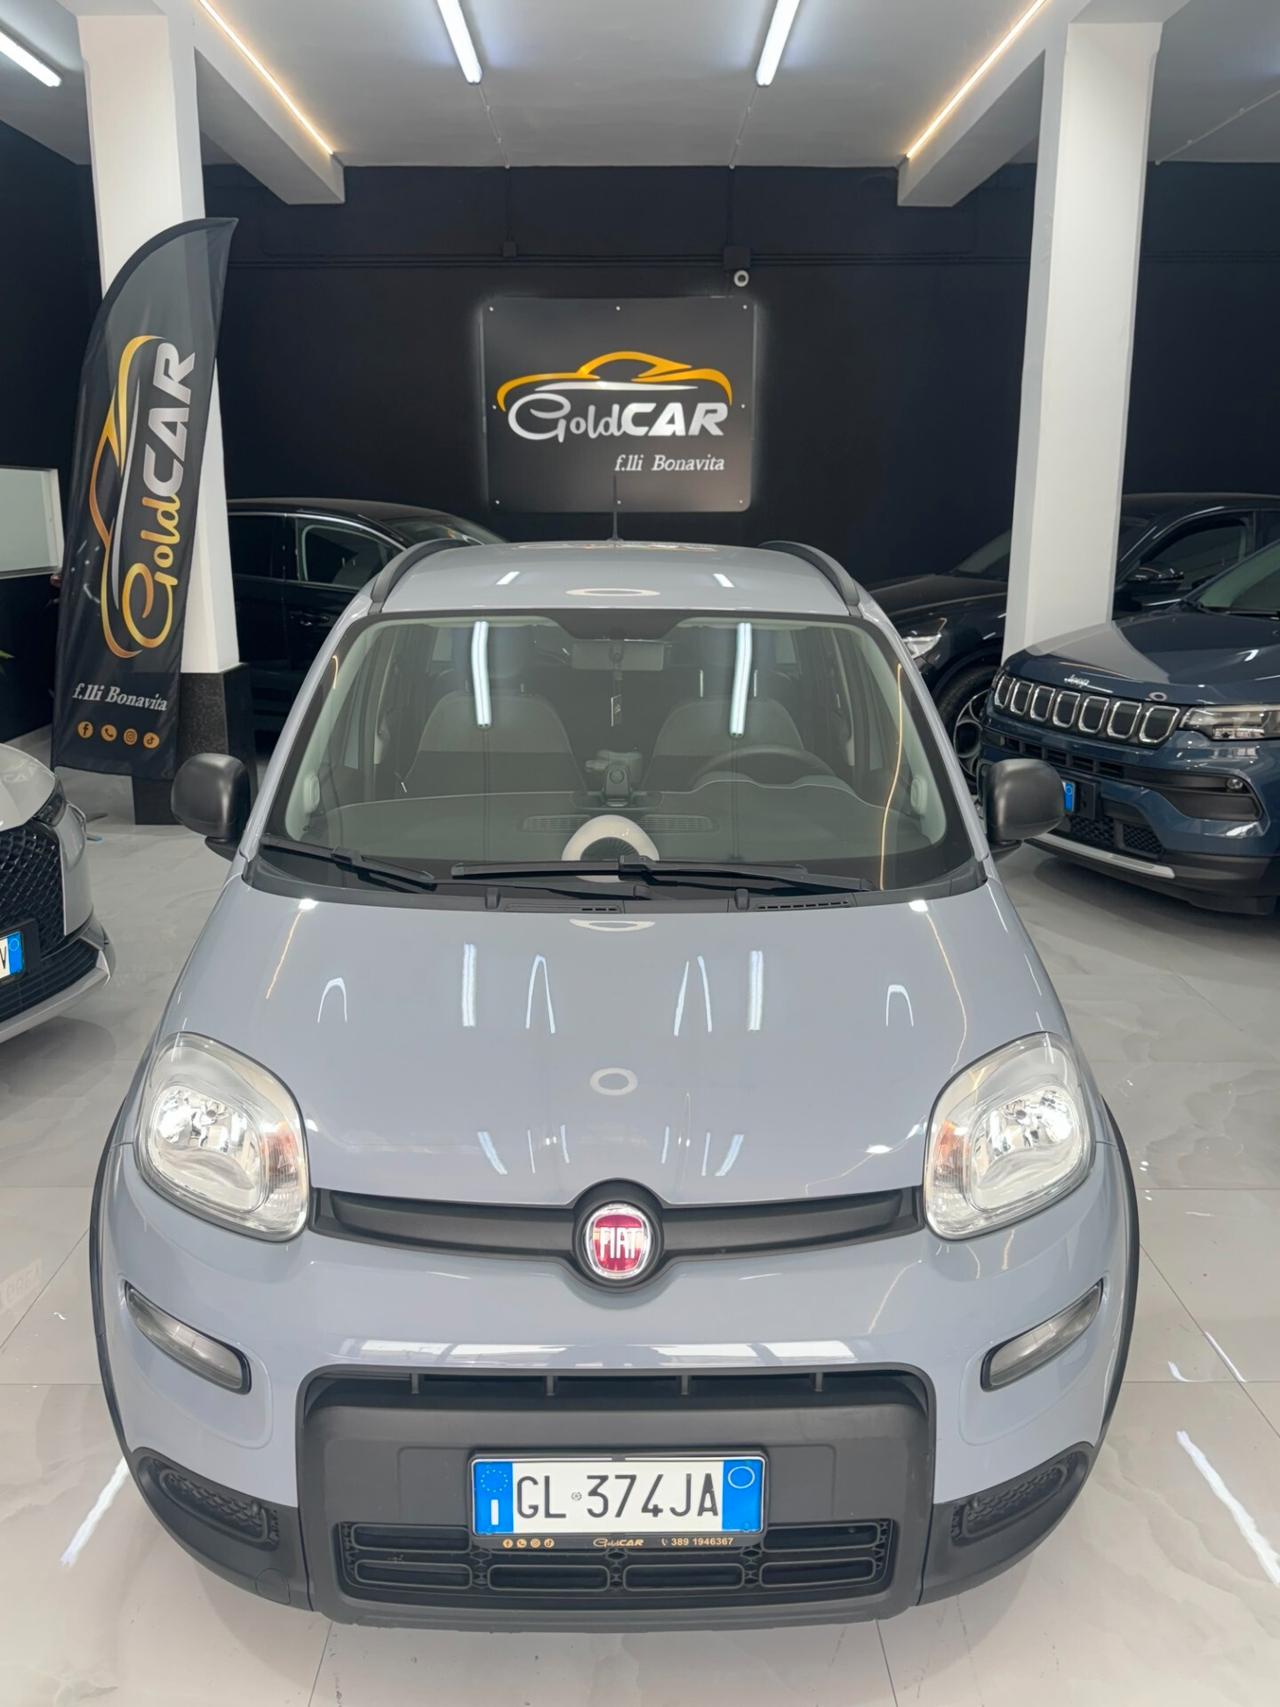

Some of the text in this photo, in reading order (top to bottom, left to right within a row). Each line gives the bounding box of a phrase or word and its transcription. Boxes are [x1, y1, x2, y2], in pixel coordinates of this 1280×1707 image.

[508, 392, 729, 443] GoldCAR
[614, 453, 726, 472] f.lli Bonavita
[121, 341, 196, 649] GoldCAR
[1063, 673, 1091, 688] Jeep
[72, 682, 168, 711] f.lli Bonavita
[599, 1226, 643, 1261] FIAT
[671, 1537, 690, 1547] 389
[692, 1536, 735, 1547] 1946367
